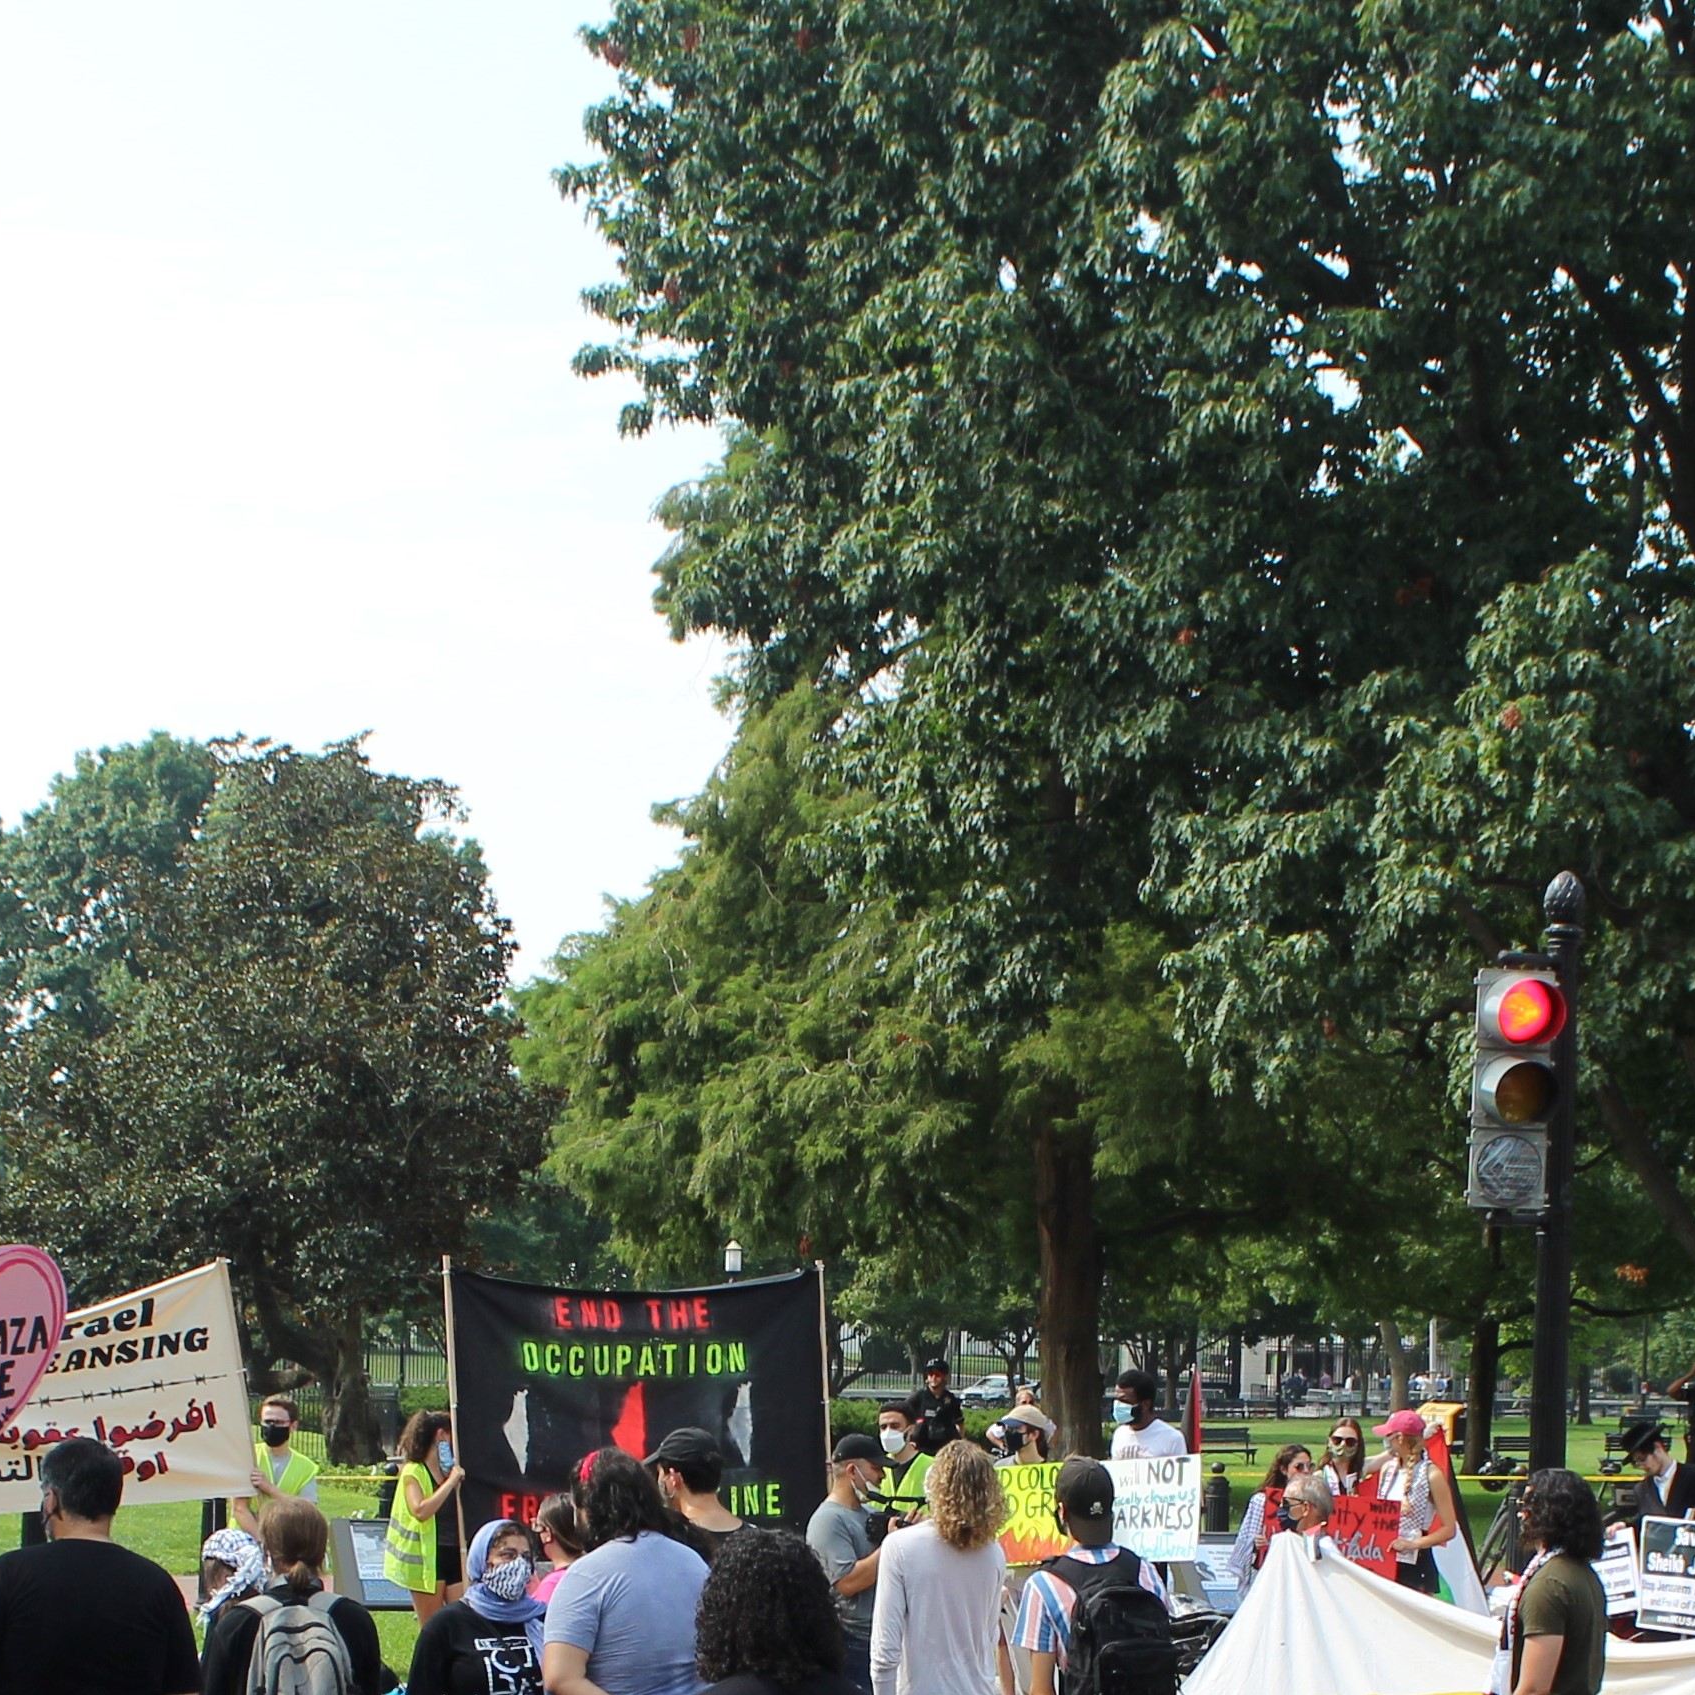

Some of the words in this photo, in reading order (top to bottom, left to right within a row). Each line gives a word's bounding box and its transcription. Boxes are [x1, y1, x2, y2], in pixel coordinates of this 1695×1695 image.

[60, 1298, 155, 1342] rael
[554, 1297, 623, 1329] END
[645, 1296, 712, 1329] THE
[44, 1327, 209, 1374] EANSING
[521, 1341, 748, 1376] OCCUPATION
[1146, 1456, 1192, 1487] NOT
[1114, 1503, 1195, 1531] ARKNESS
[1370, 1502, 1400, 1515] with
[1373, 1517, 1399, 1532] the
[1333, 1530, 1385, 1563] tifada
